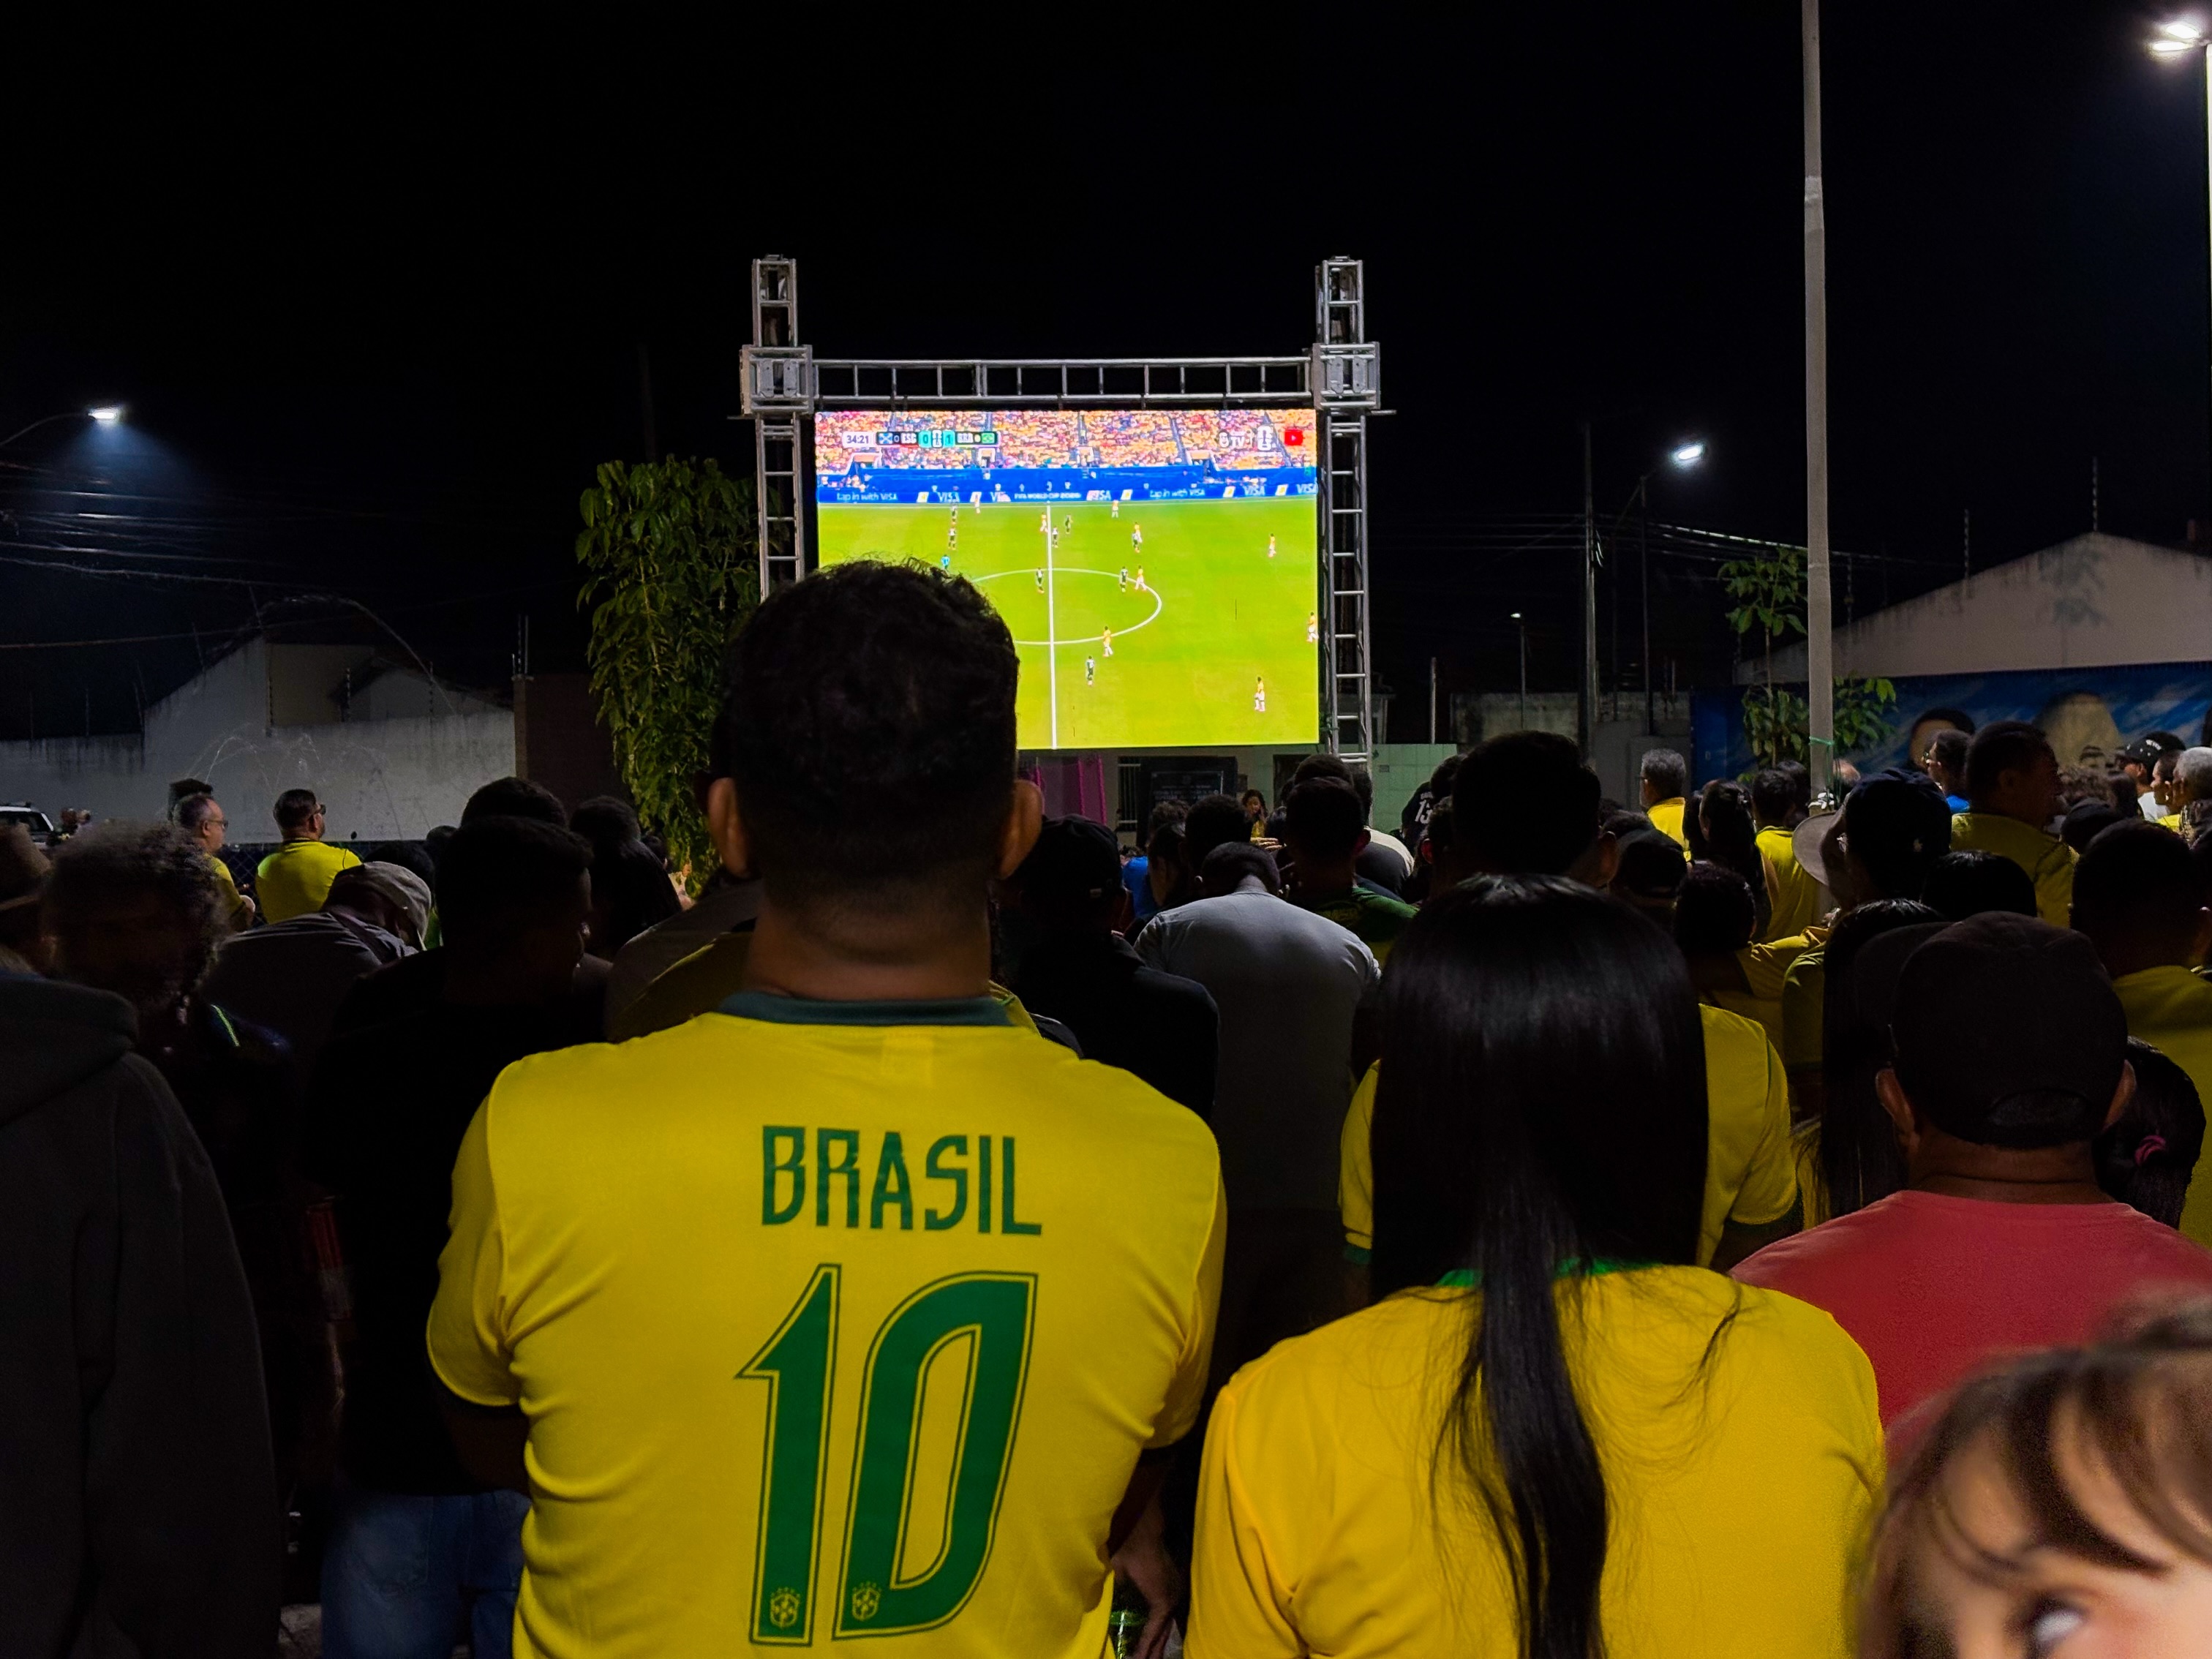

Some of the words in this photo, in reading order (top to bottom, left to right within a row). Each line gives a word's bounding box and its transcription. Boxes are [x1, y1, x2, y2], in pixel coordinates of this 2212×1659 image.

[846, 434, 869, 444] 34:21
[1244, 484, 1265, 496] VISA
[880, 492, 898, 500] VISA
[937, 492, 960, 503] VISA
[761, 1125, 1042, 1236] BRASIL
[734, 1263, 1039, 1647] 10
